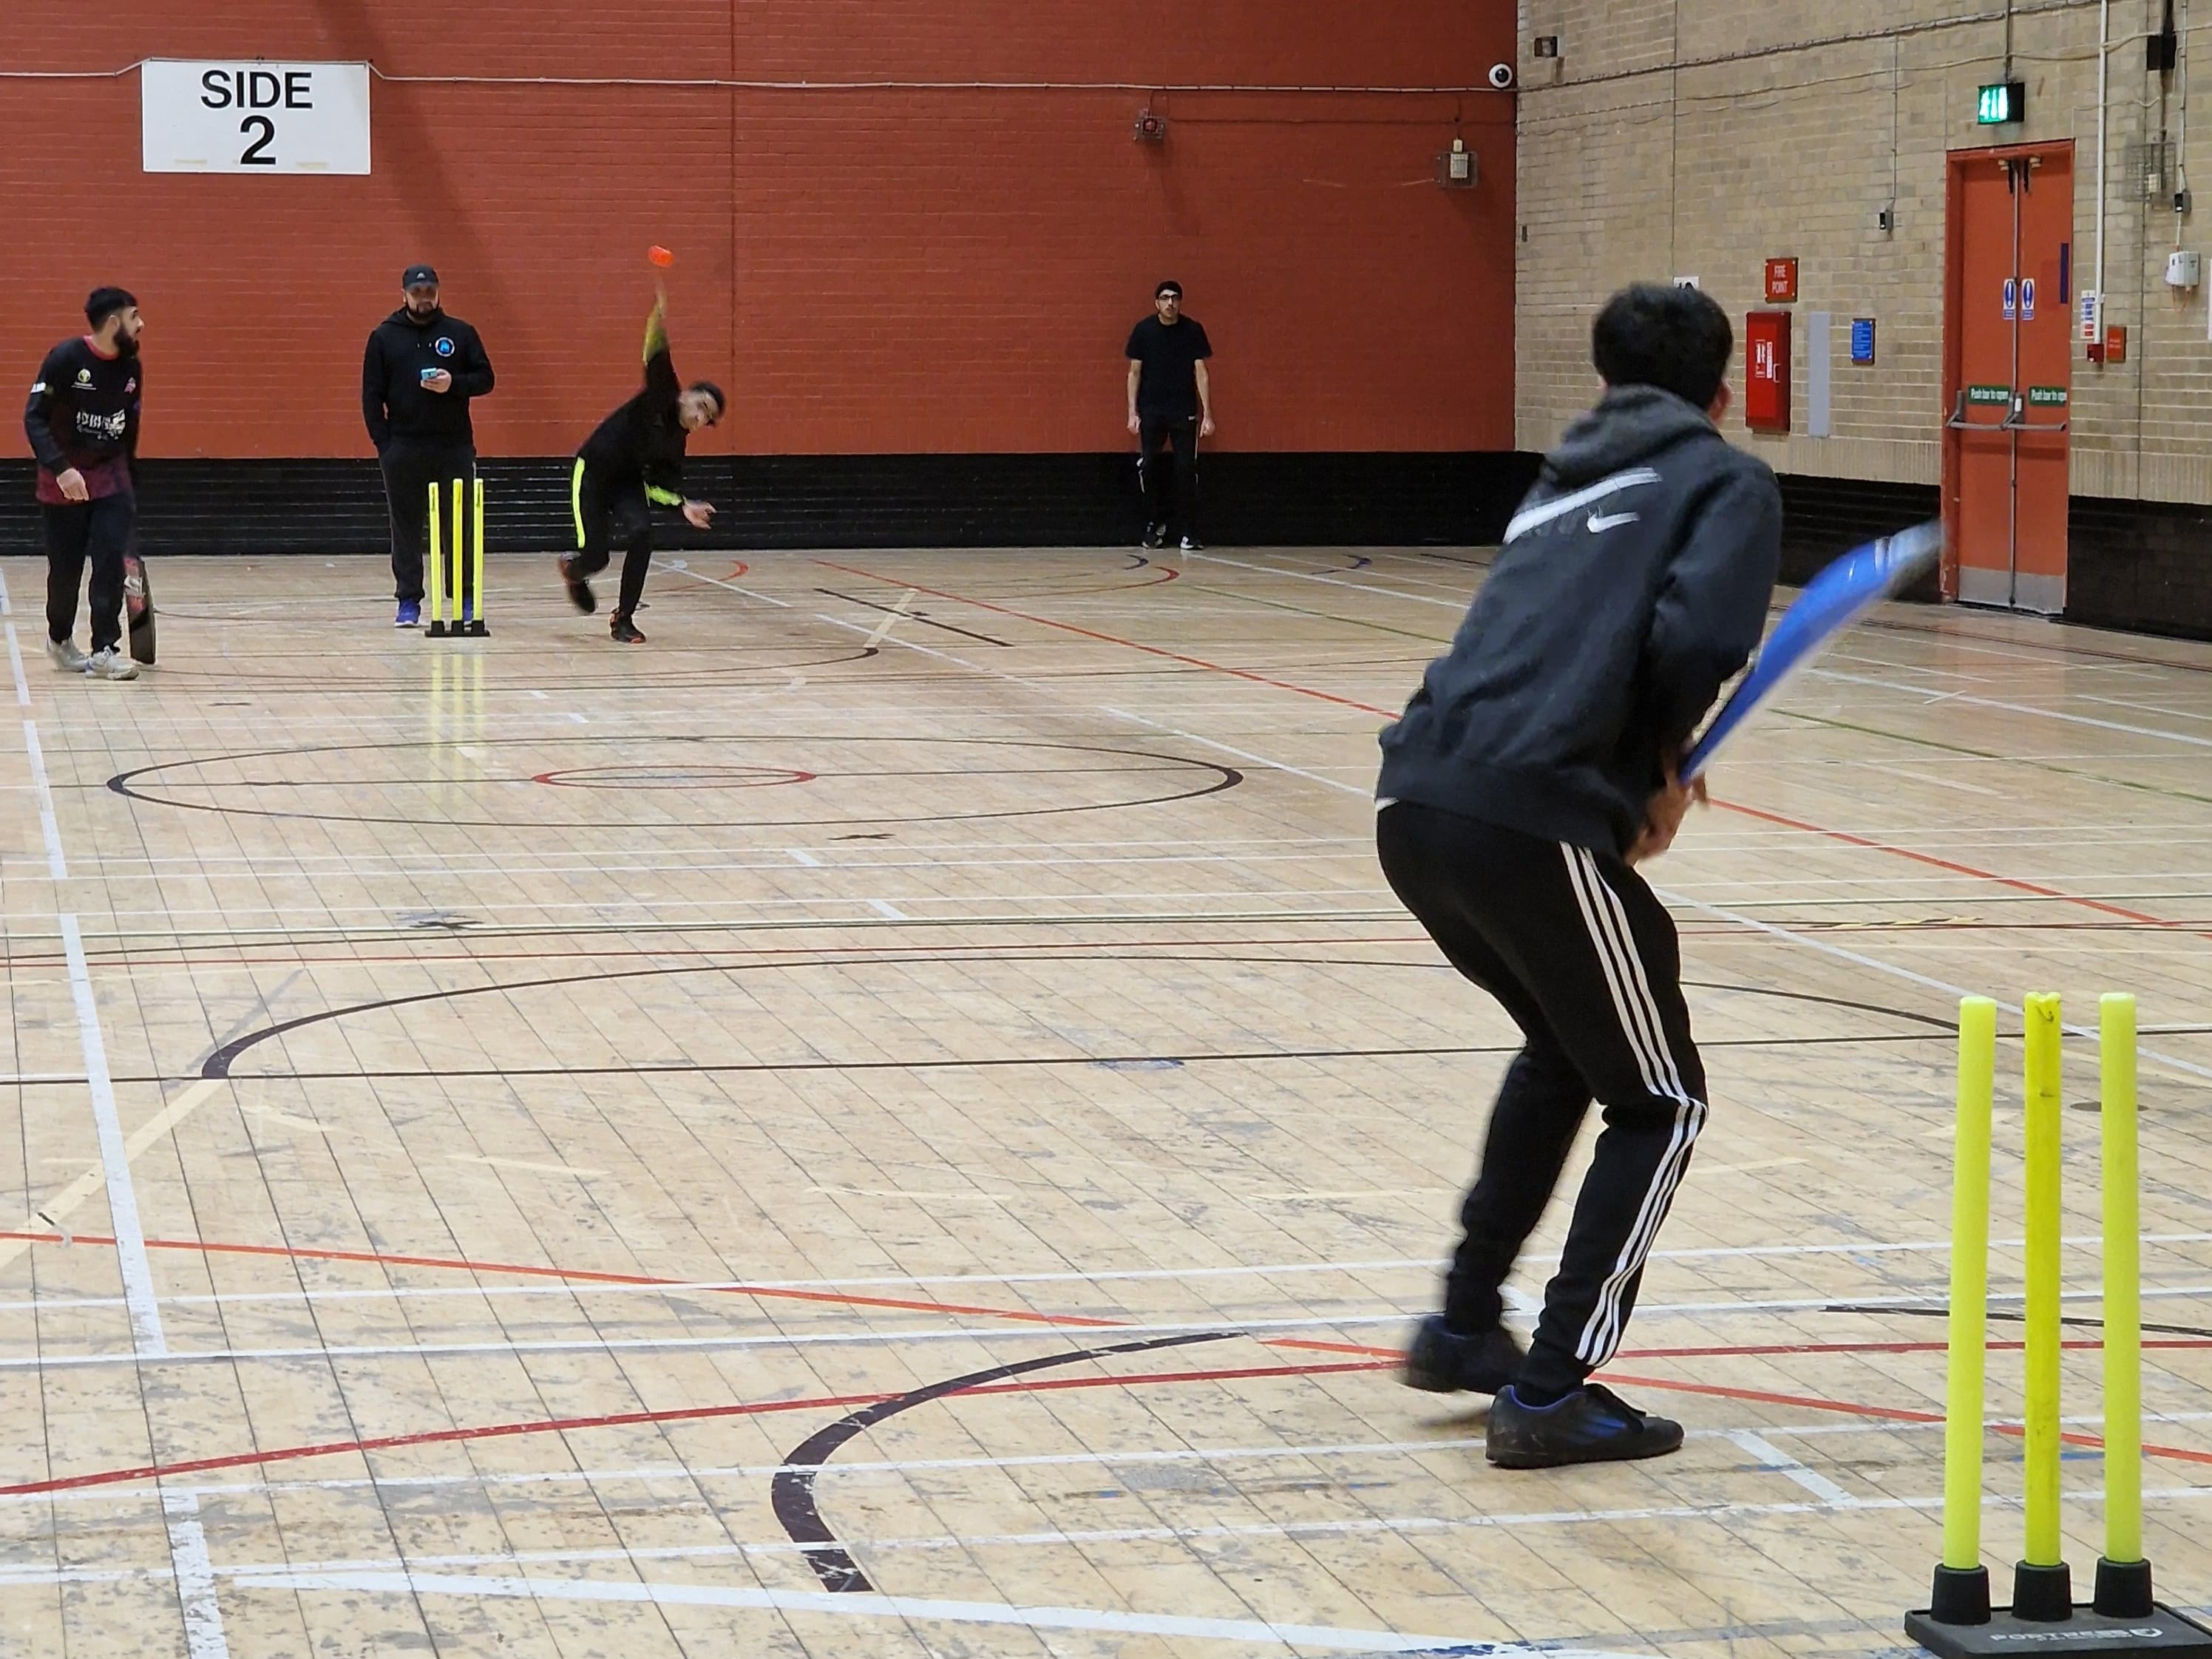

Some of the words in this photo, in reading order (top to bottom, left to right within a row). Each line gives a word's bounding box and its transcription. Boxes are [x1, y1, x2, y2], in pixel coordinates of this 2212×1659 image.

[200, 69, 313, 109] SIDE
[240, 115, 276, 165] 2
[1774, 265, 1786, 278] FIRE
[1771, 280, 1788, 294] POINT
[1971, 387, 1982, 399] Push
[1982, 387, 1990, 399] bar
[1990, 389, 1996, 399] to
[1996, 390, 2009, 401] open
[2031, 389, 2042, 401] Push
[2043, 390, 2051, 401] bar
[2052, 390, 2057, 401] to
